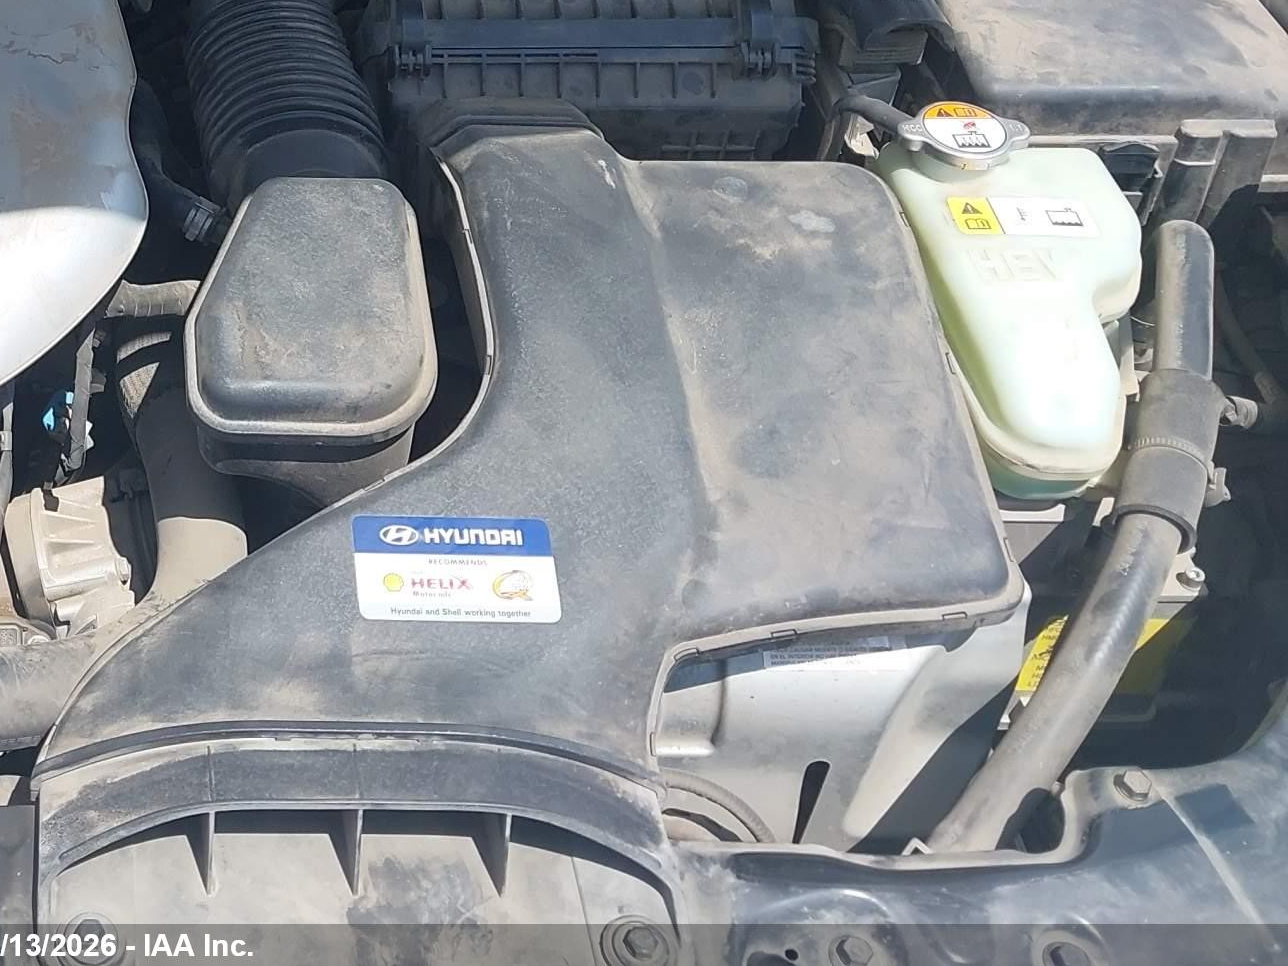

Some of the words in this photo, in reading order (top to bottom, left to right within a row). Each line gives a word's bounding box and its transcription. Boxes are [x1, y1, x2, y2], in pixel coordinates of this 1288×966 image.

[424, 527, 524, 546] HYUNDAI
[411, 577, 472, 590] HELIX
[390, 607, 423, 616] Hyundai
[425, 608, 440, 616] and
[442, 608, 462, 616] Shell
[464, 609, 496, 618] working
[498, 610, 531, 618] together
